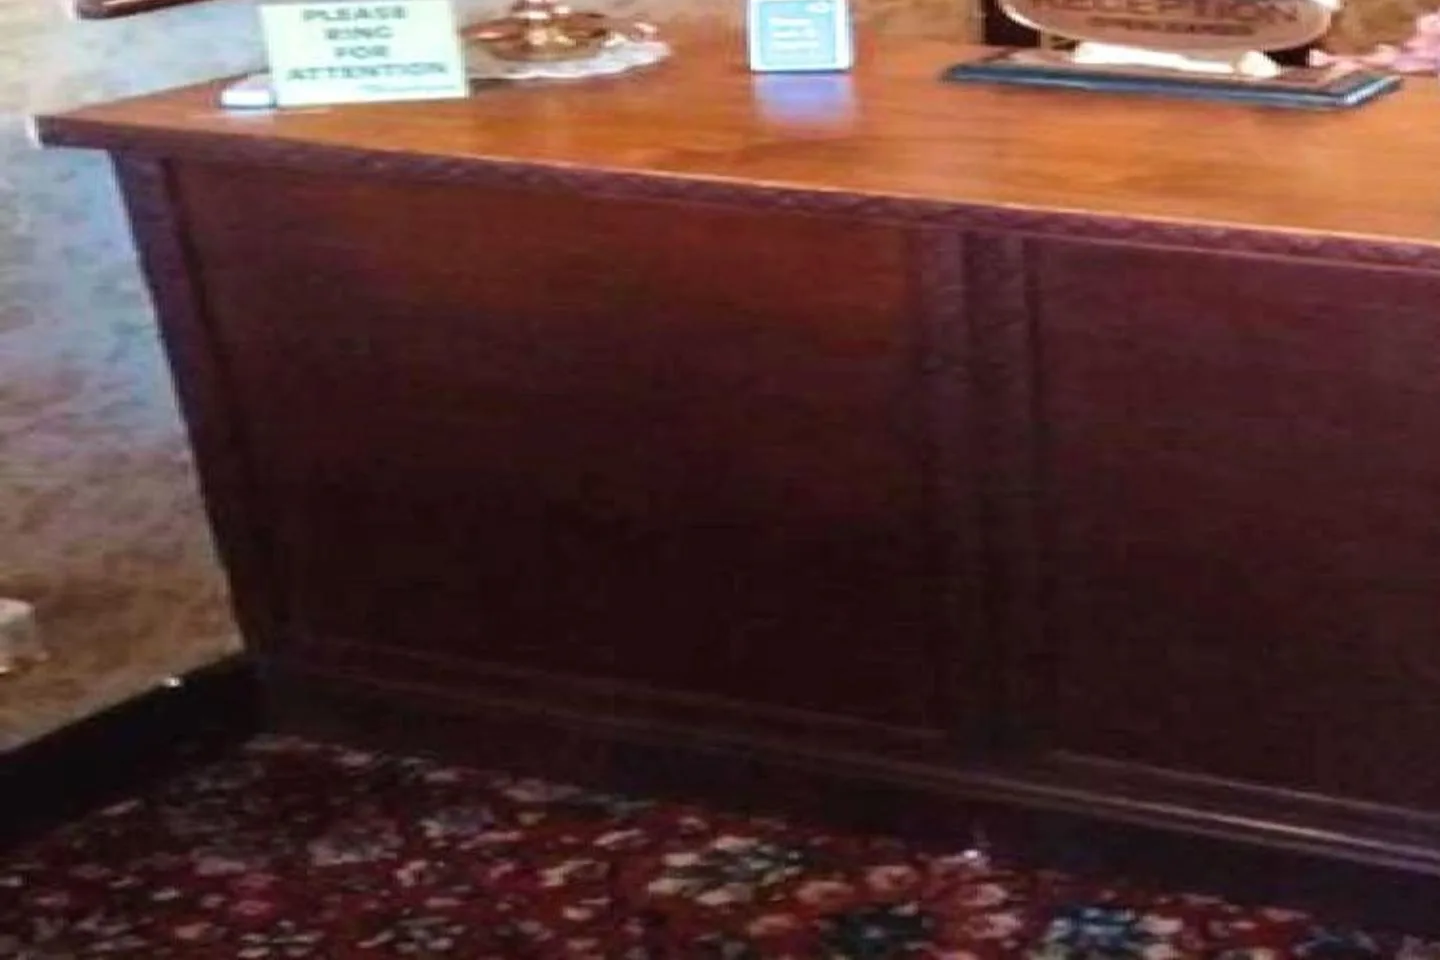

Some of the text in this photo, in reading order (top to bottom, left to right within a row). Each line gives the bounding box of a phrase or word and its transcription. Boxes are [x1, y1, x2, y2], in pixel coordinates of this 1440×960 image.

[302, 6, 407, 22] PLEASE
[324, 26, 394, 41] RING
[333, 46, 390, 60] FOR
[286, 62, 449, 81] ATTENTION
